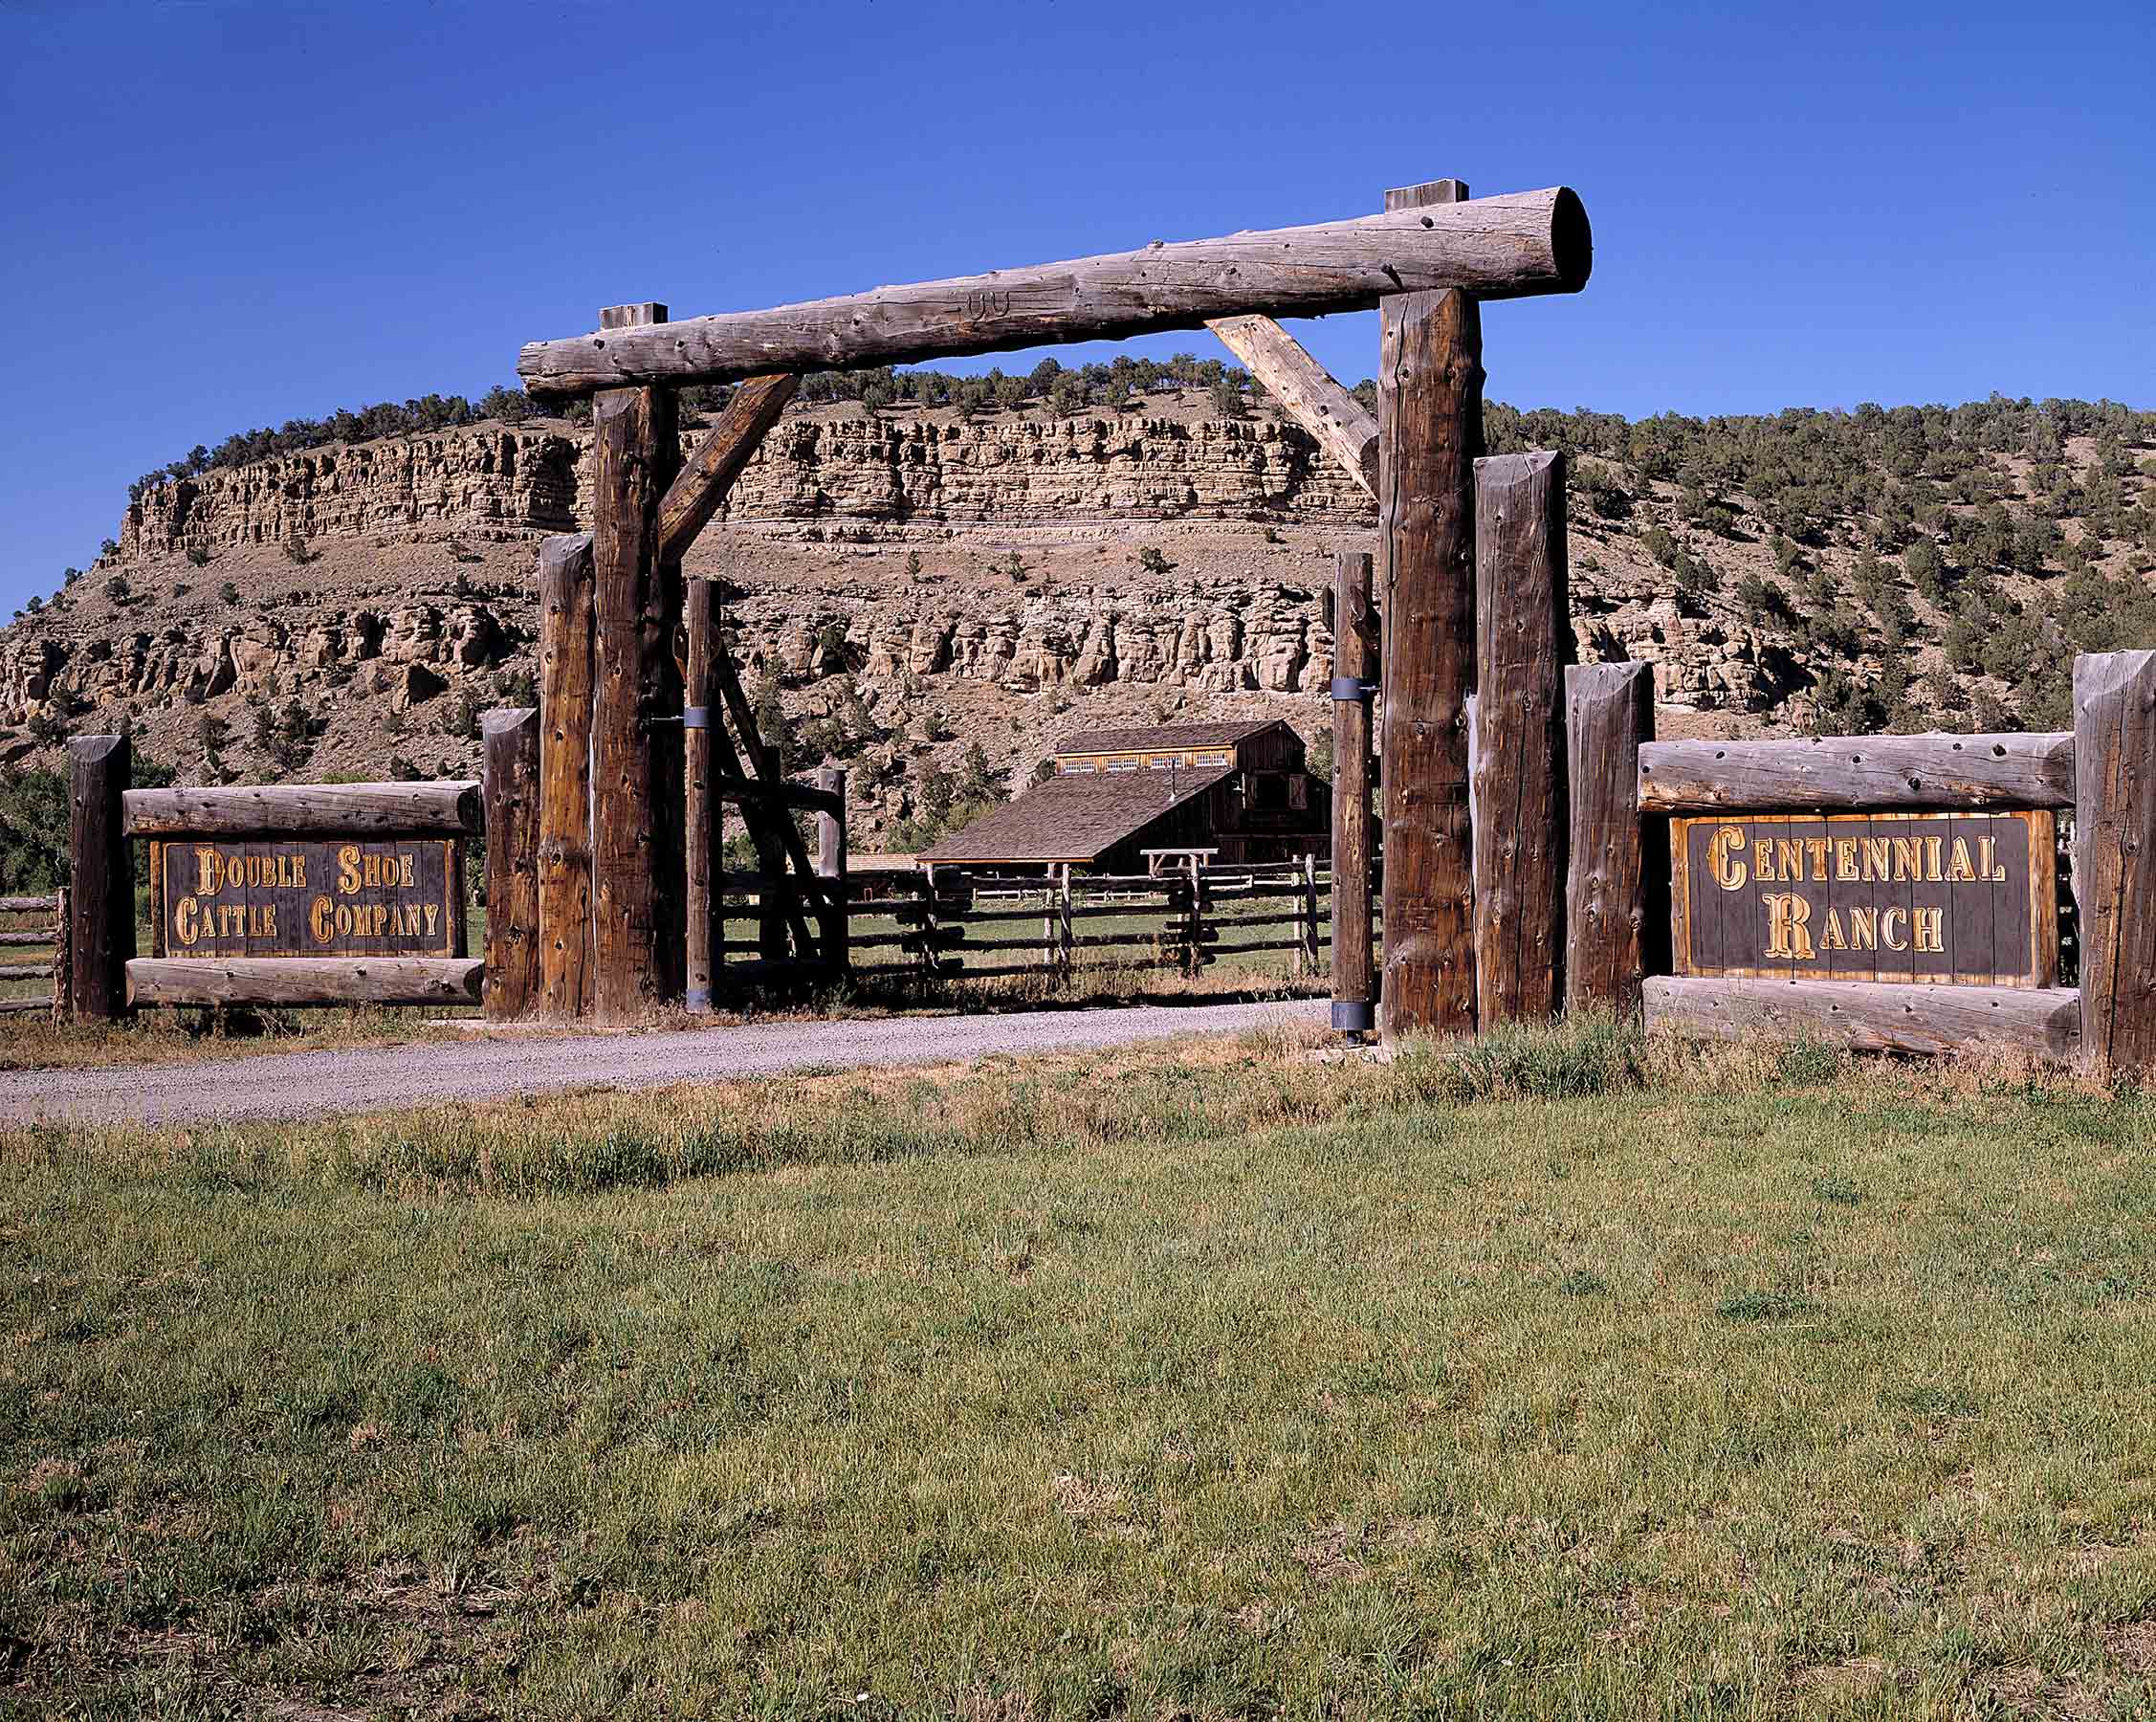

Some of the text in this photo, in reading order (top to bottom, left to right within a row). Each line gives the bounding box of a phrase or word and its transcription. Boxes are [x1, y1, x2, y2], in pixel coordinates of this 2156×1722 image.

[195, 845, 414, 895] DOUBLE SHOE
[1706, 826, 2006, 892] CENTENNIAL
[175, 894, 439, 945] CATTLE COMPANY
[1762, 893, 1945, 960] RANCH
